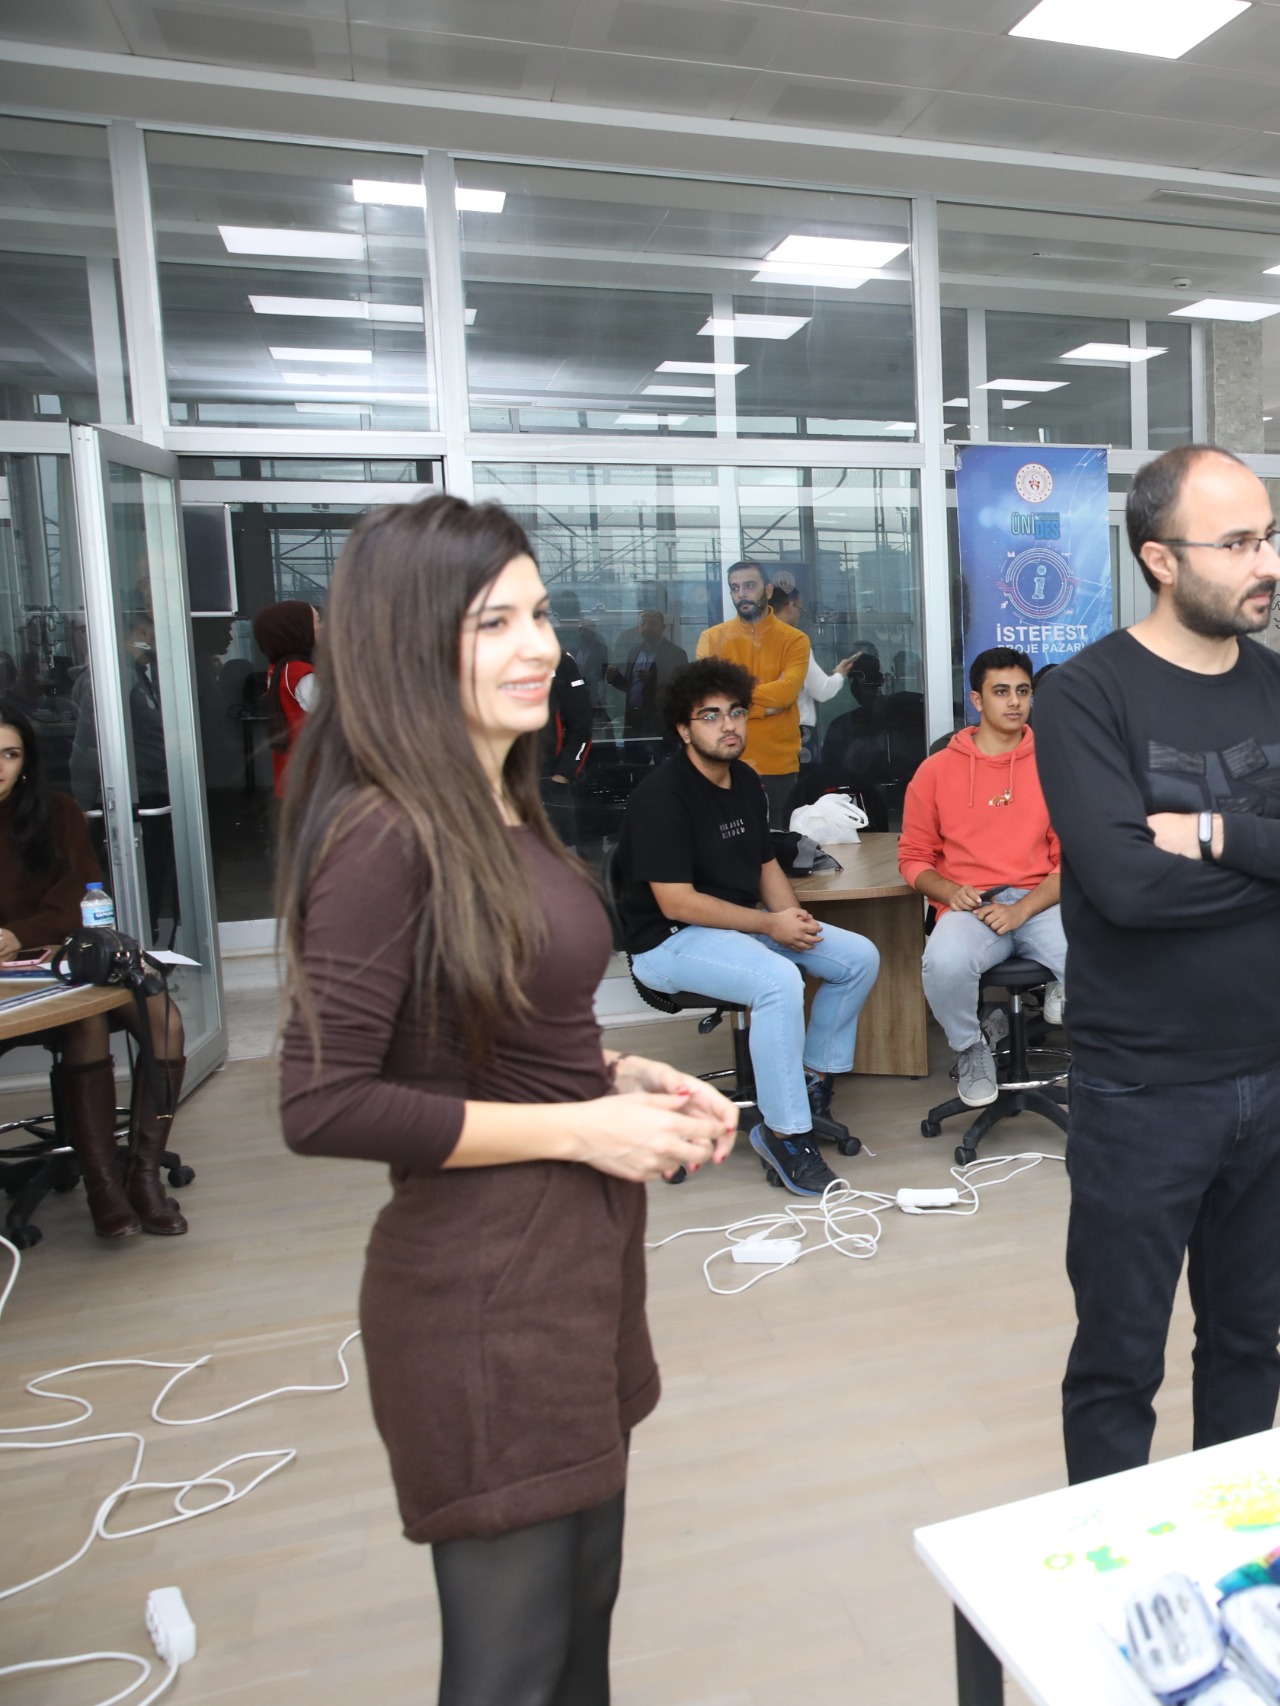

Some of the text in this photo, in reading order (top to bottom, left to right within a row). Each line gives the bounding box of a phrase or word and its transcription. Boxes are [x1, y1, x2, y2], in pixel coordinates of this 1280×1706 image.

[1035, 519, 1060, 540] DES
[997, 623, 1088, 642] İSTEFEST
[997, 643, 1039, 654] OJE
